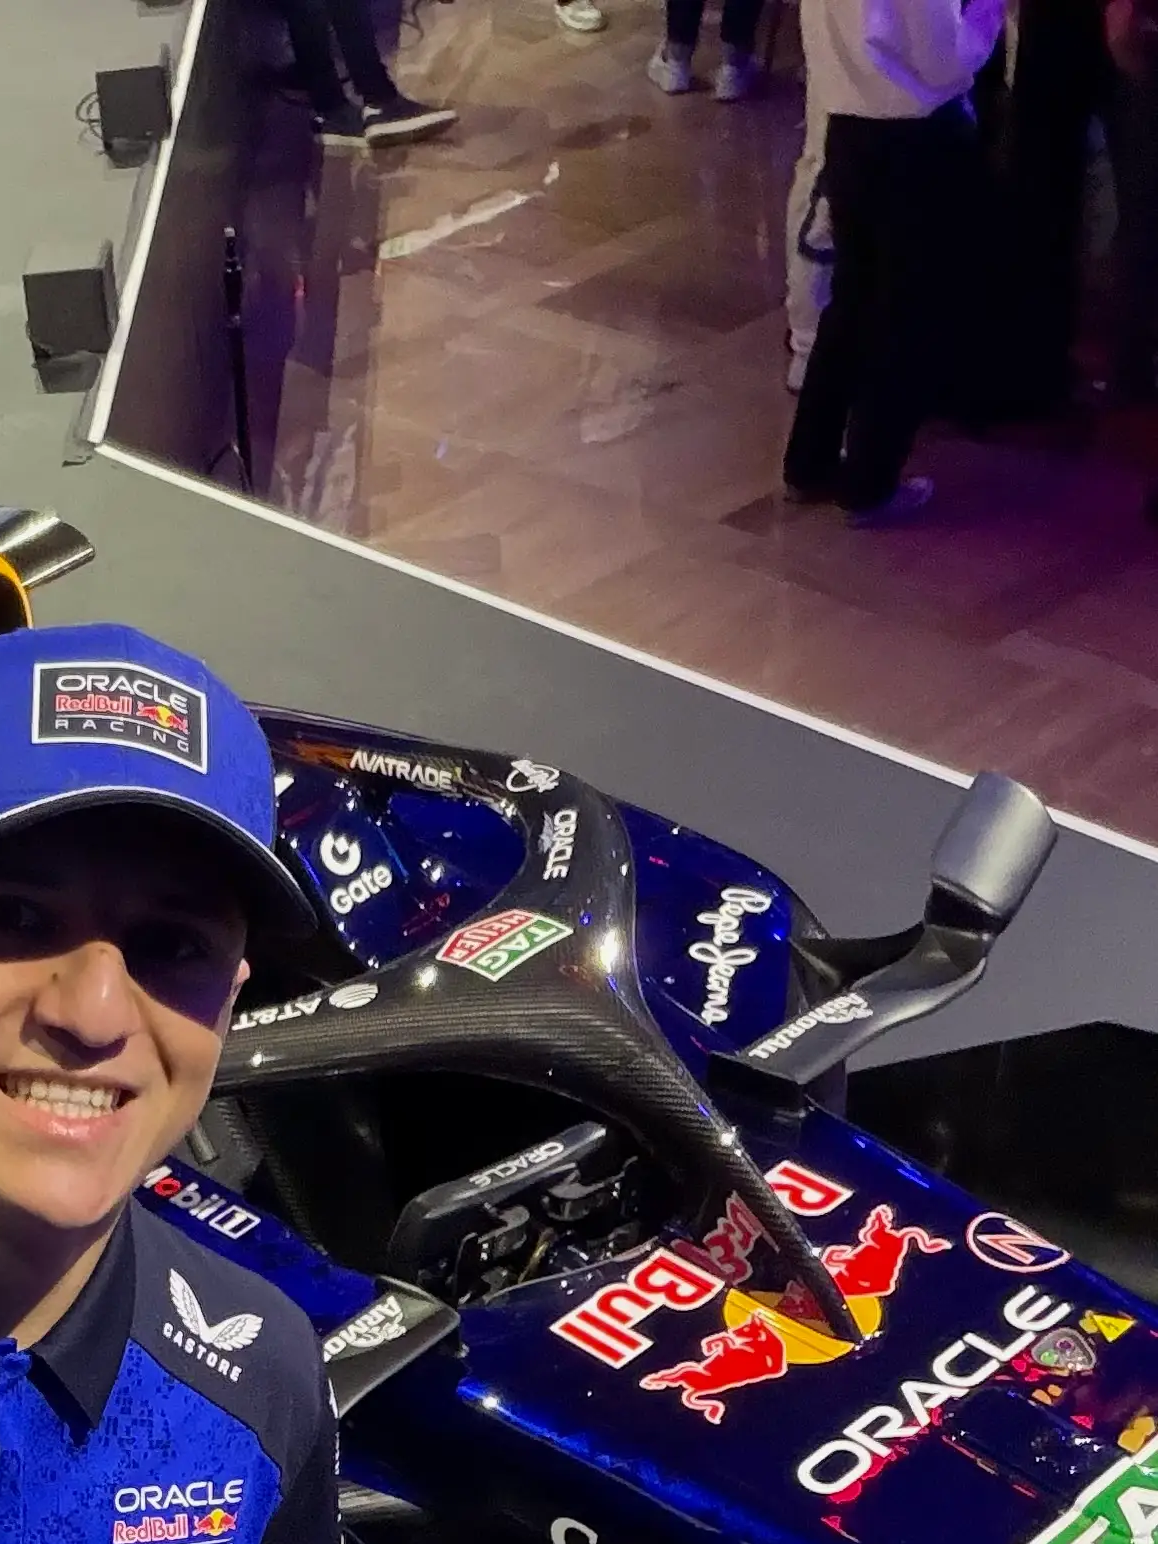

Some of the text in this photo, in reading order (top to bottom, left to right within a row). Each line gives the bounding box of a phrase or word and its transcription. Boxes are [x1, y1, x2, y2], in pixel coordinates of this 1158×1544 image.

[56, 674, 189, 714] ORACLE
[55, 719, 190, 753] RACING
[349, 749, 452, 790] AVATRADE
[543, 809, 578, 881] ORACLE
[329, 863, 394, 915] Gate
[448, 914, 528, 960] HEUER
[476, 926, 558, 971] TAG
[231, 997, 323, 1032] AT&T
[469, 1140, 565, 1188] ORACLE
[549, 1246, 726, 1369] Bull
[162, 1322, 244, 1382] CASTORE
[798, 1284, 1075, 1494] ORACLE
[114, 1478, 244, 1514] ORACLE
